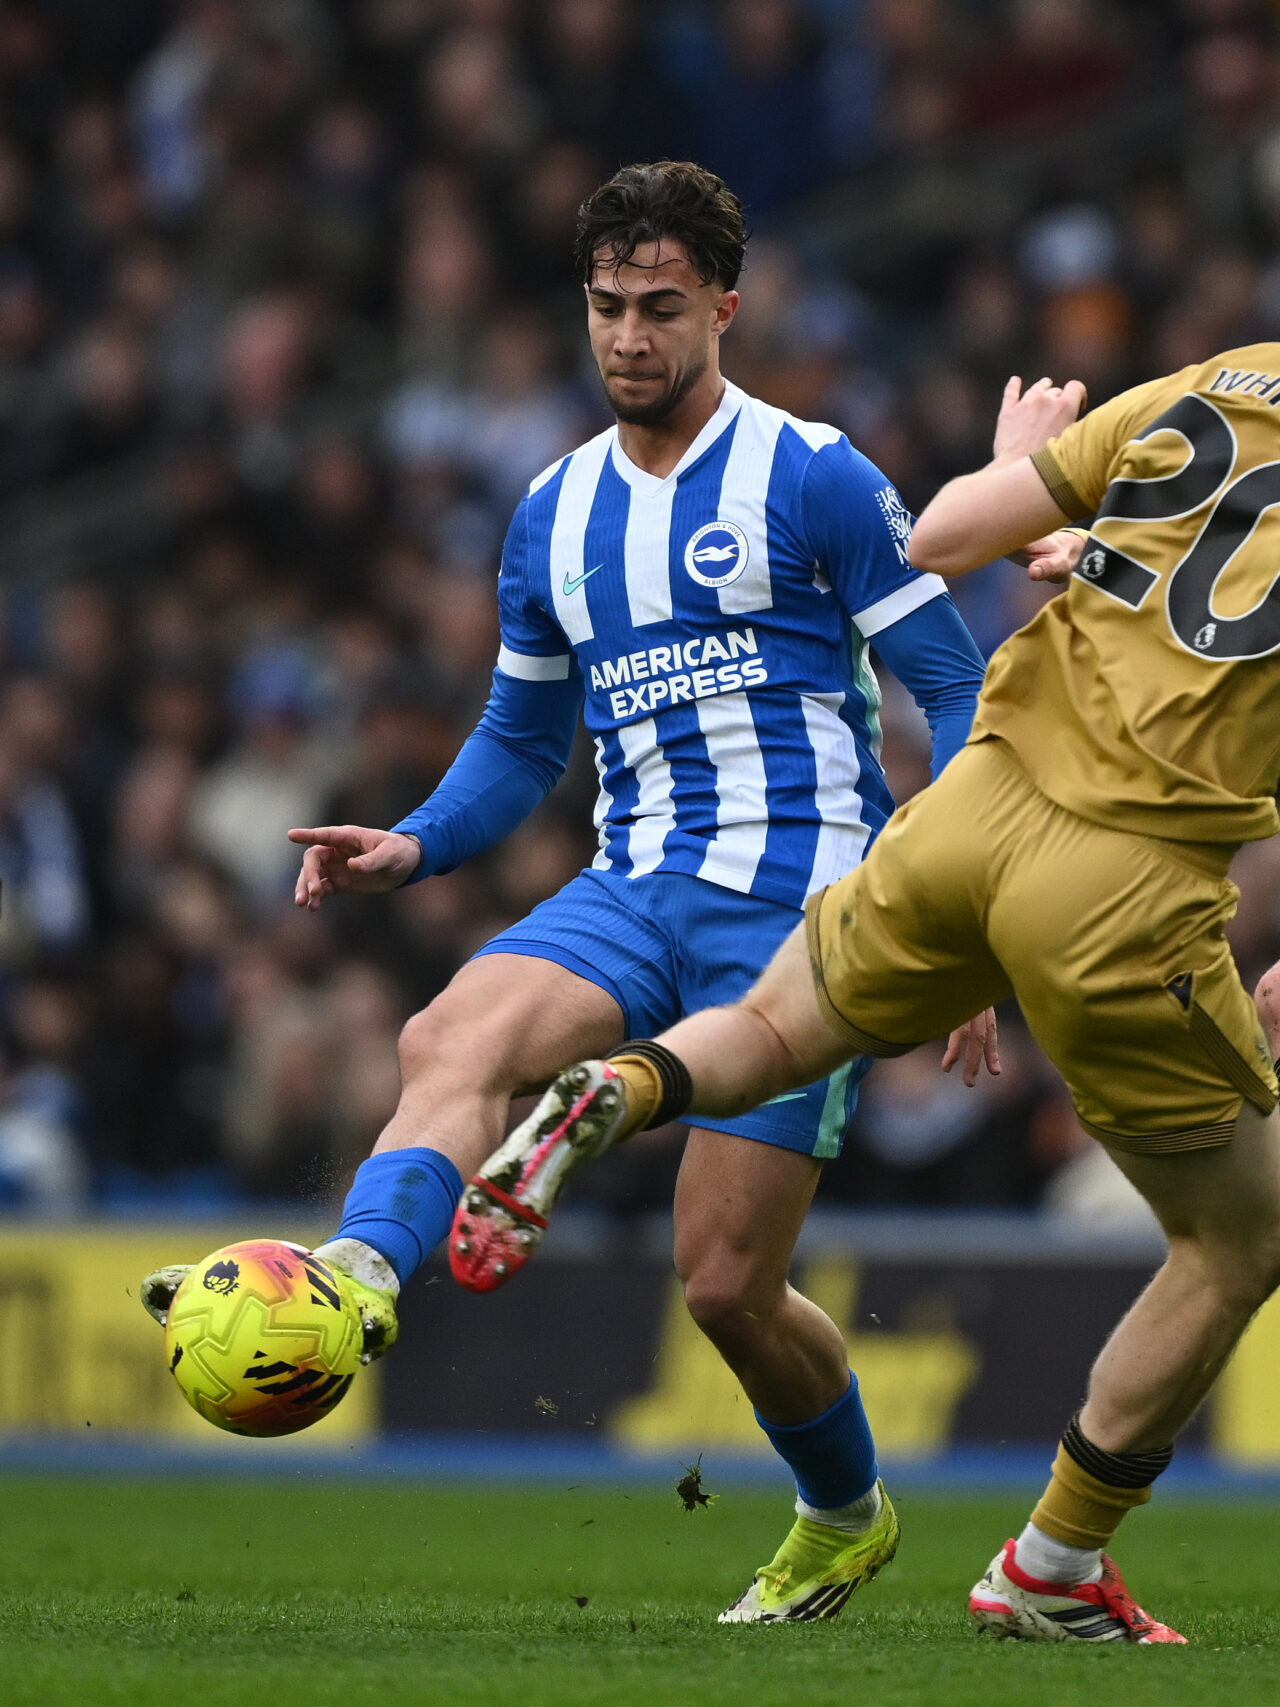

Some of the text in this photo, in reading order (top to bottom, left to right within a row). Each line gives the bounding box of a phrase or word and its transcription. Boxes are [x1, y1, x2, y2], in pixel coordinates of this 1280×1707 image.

[692, 523, 721, 543] BRIGHTON
[728, 525, 742, 538] HOVE
[703, 577, 728, 585] ALBION
[589, 627, 759, 692] AMERICAN
[609, 657, 768, 720] EXPRESS
